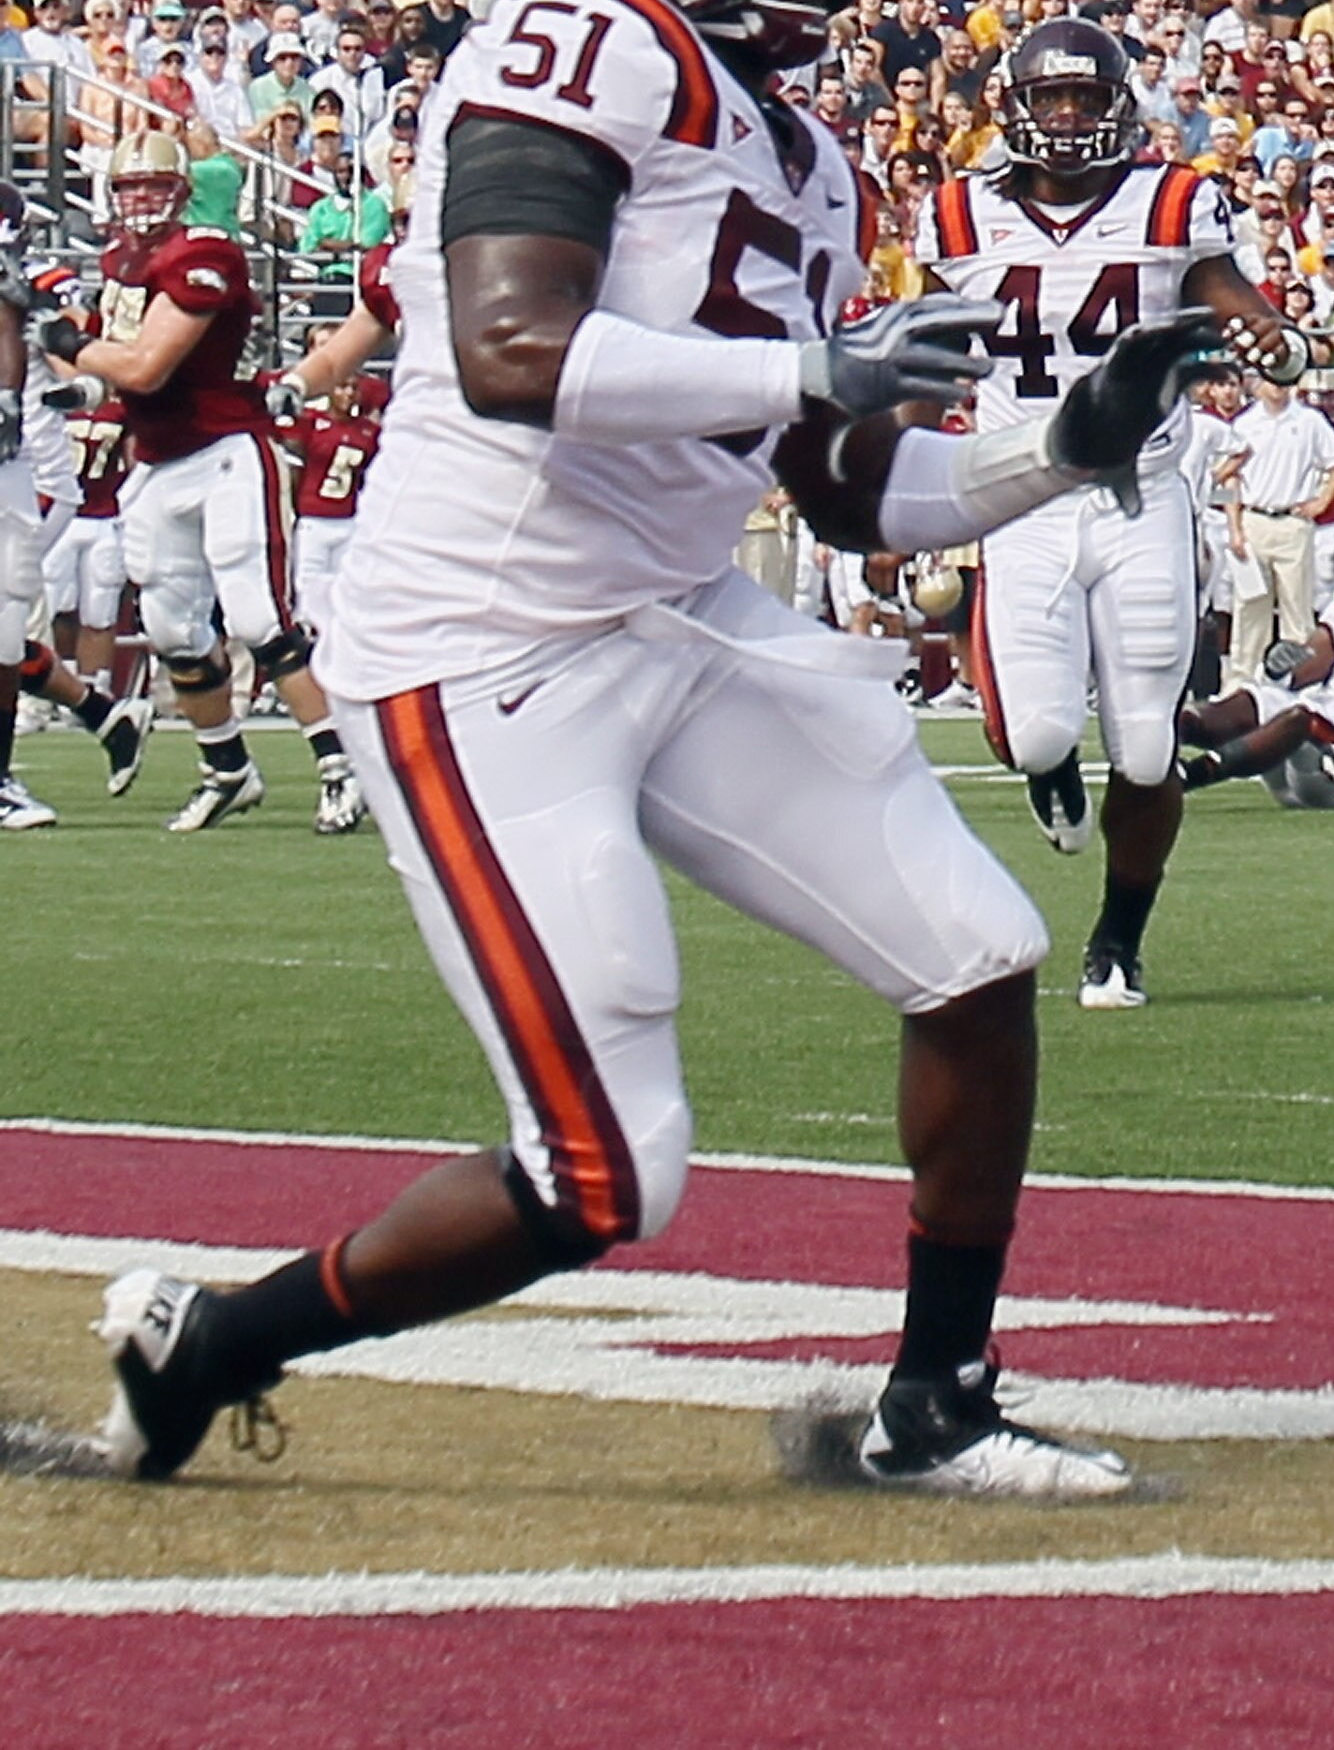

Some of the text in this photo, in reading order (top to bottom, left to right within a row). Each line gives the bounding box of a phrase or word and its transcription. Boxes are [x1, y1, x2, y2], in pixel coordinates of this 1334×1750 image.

[501, 0, 614, 109] 51
[982, 263, 1141, 399] 44
[319, 444, 365, 499] 5
